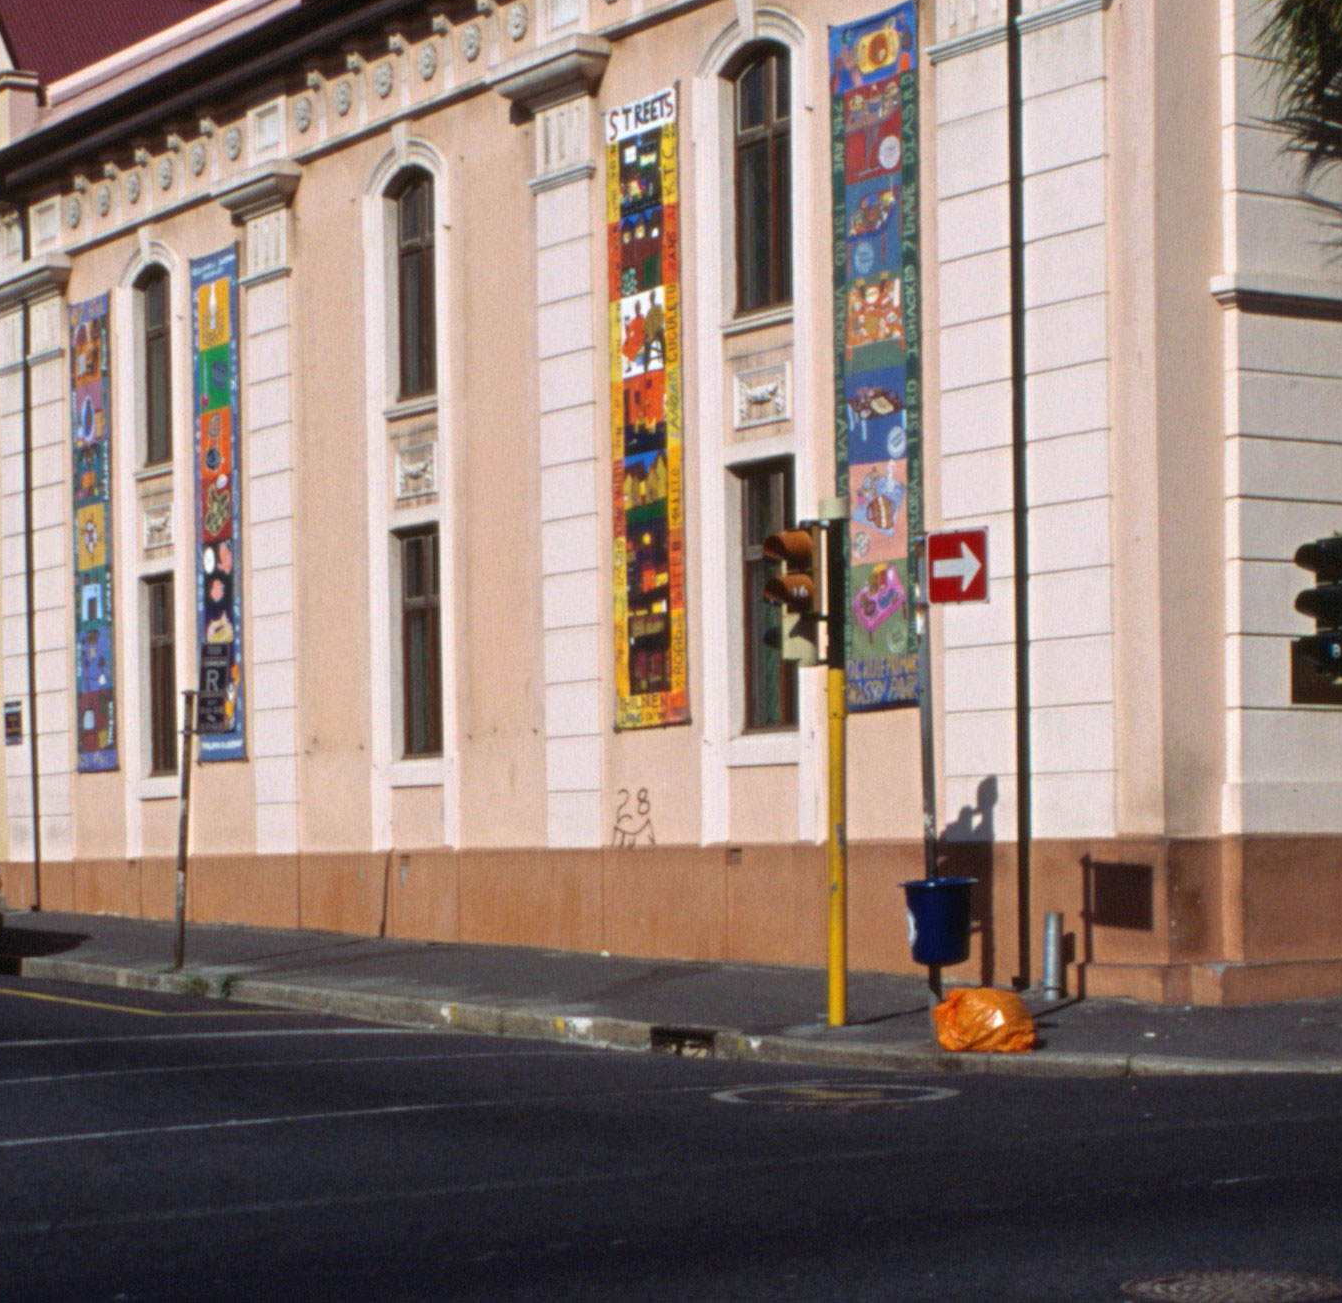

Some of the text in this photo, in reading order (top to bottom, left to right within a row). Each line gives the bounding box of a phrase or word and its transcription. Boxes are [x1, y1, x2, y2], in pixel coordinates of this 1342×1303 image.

[609, 91, 674, 142] STREETS
[206, 669, 220, 691] R
[616, 787, 650, 824] 28
